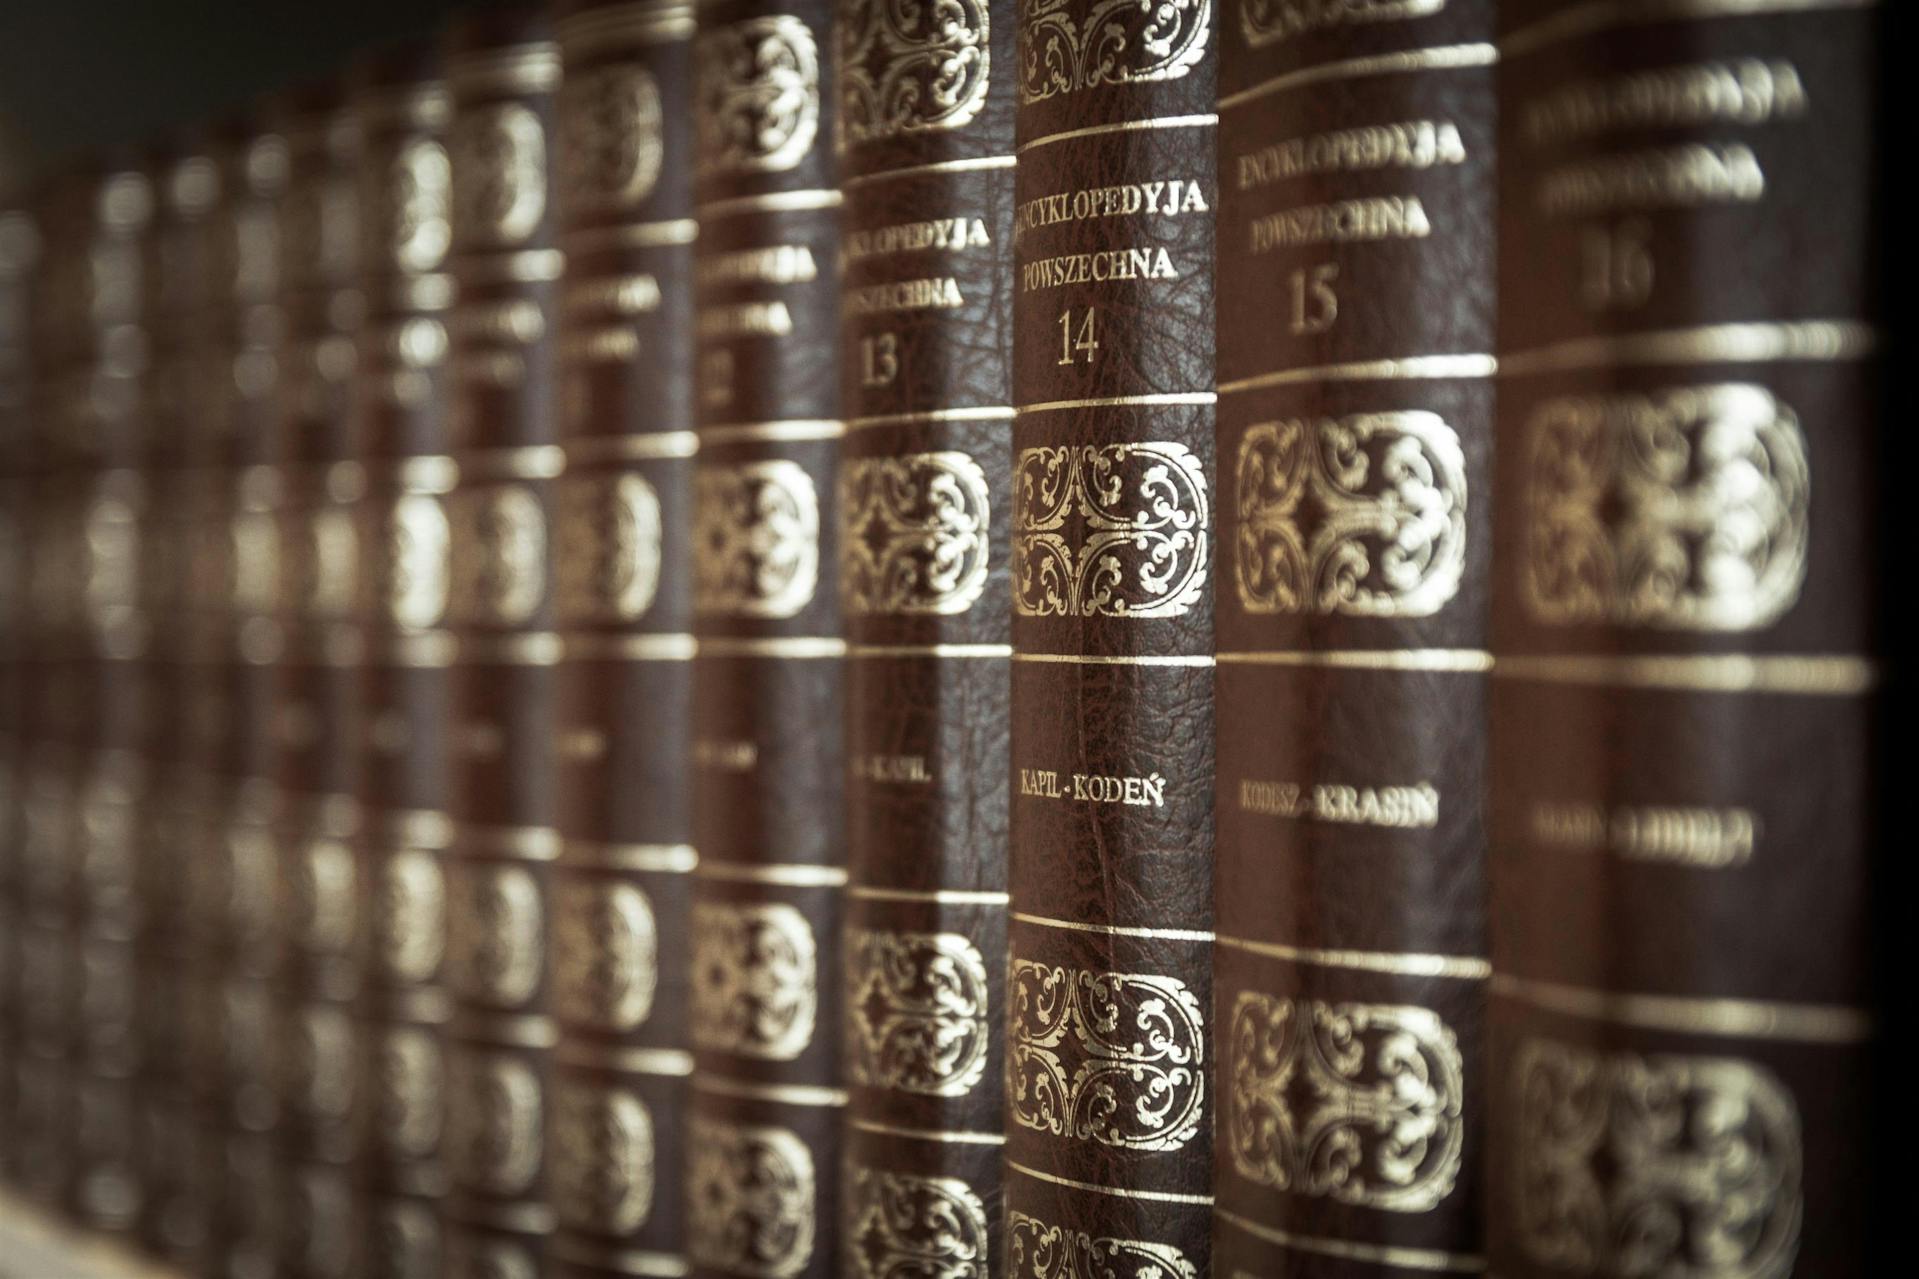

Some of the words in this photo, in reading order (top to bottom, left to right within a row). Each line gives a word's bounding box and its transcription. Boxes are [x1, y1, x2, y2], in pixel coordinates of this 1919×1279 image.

[1023, 247, 1179, 293] POWSZECHNA
[1288, 262, 1341, 334] 15
[861, 331, 899, 387] 13
[1057, 306, 1099, 365] 14
